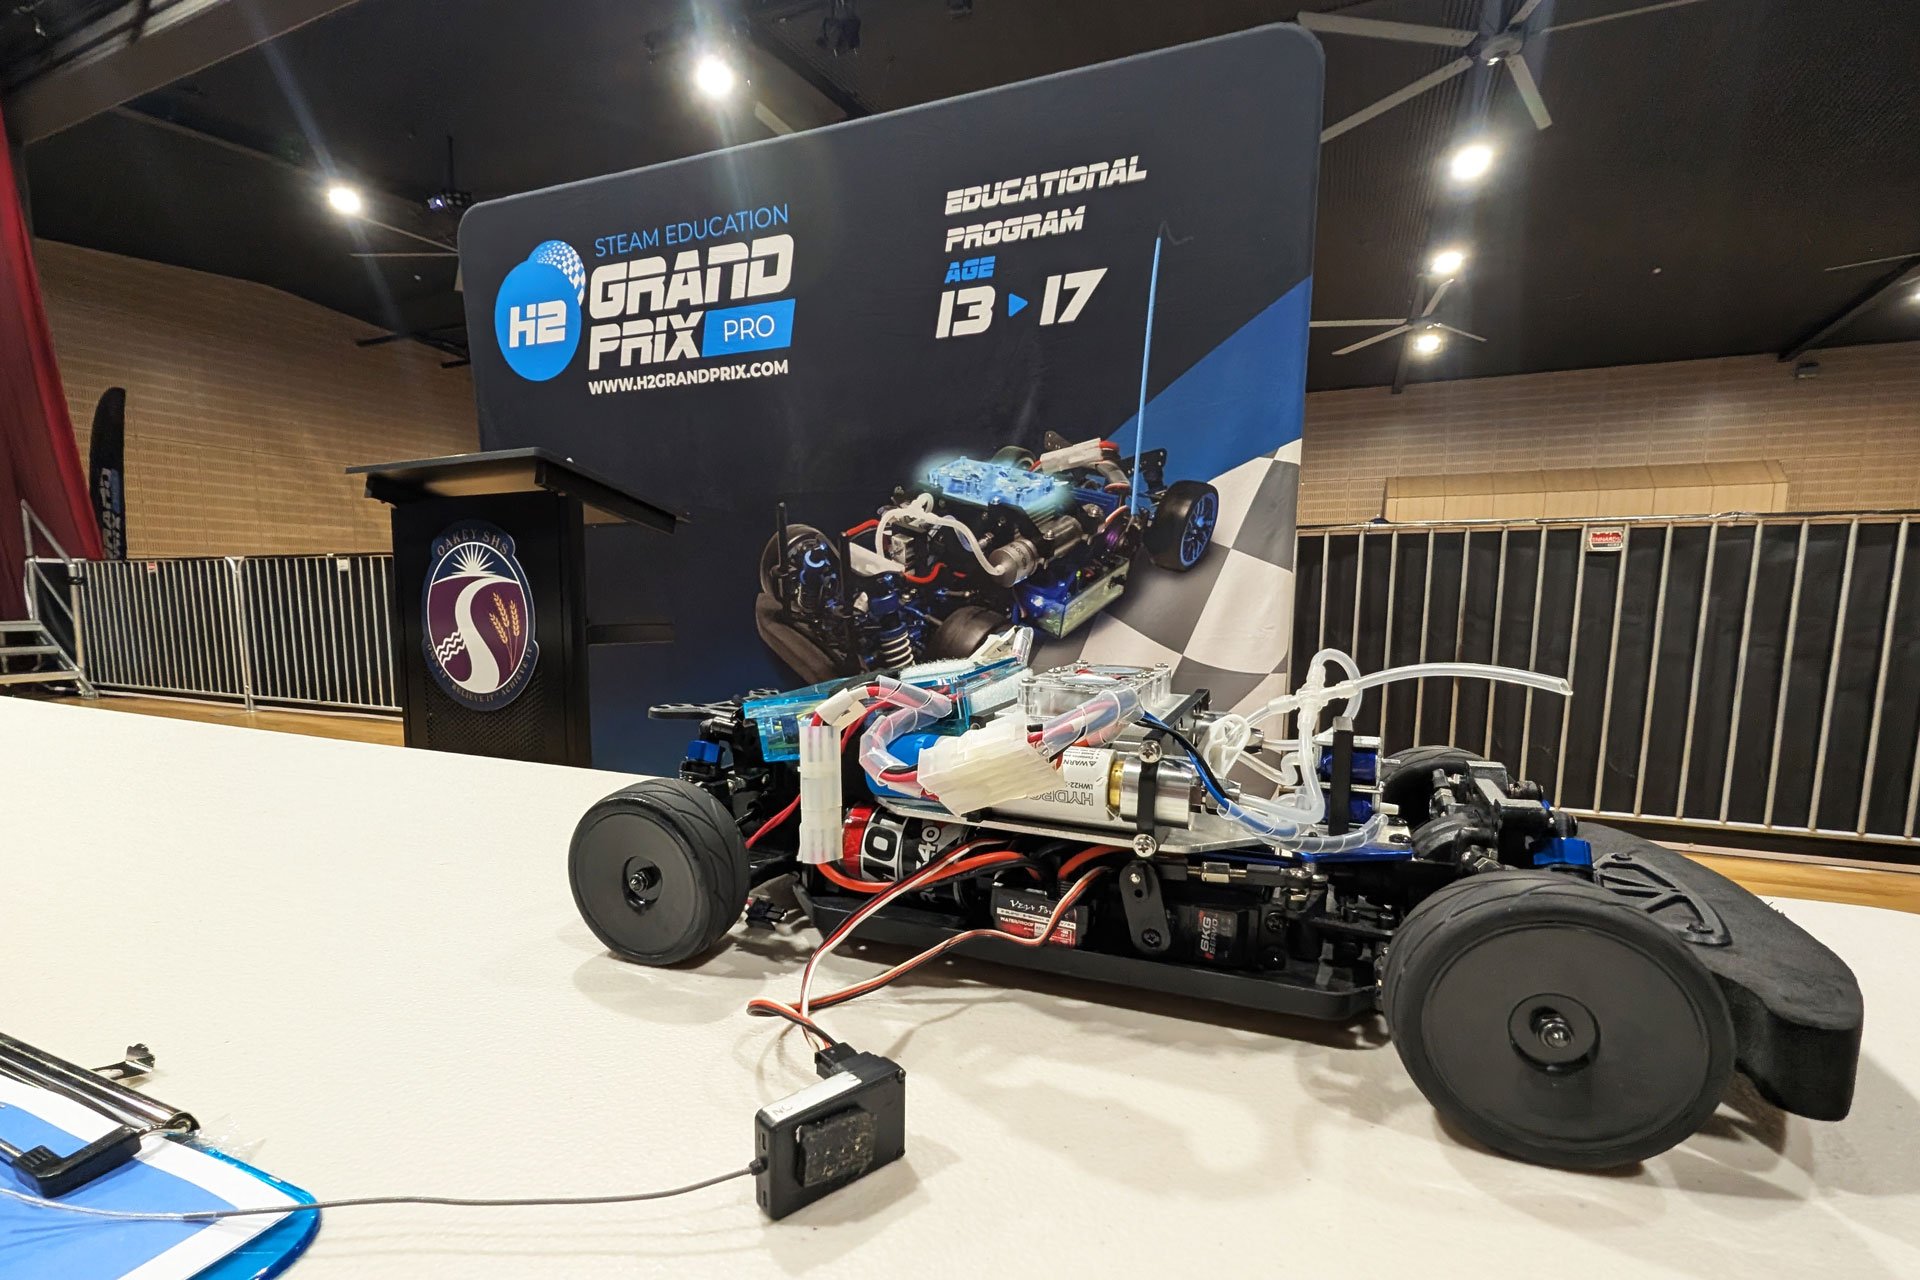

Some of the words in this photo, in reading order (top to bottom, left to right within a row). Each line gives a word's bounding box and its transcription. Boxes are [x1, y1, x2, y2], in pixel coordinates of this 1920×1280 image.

[944, 155, 1148, 216] EDUCATIONAL
[595, 228, 659, 257] STEAM
[666, 203, 789, 244] EDUCATION
[944, 205, 1086, 252] PROGRAM
[589, 233, 794, 319] GRAND
[944, 255, 996, 284] AGE
[509, 300, 567, 348] H2
[935, 285, 996, 339] 13
[1039, 267, 1108, 326] 17
[588, 310, 704, 370] PRIX
[724, 314, 775, 342] PRO
[588, 359, 789, 395] WWW.H2GRANDPRIX.COM
[437, 529, 478, 556] OAKEY
[482, 530, 509, 556] SHS
[451, 683, 485, 703] BELIEVE
[501, 661, 529, 697] ACHIEVE
[1200, 916, 1212, 952] 6KG
